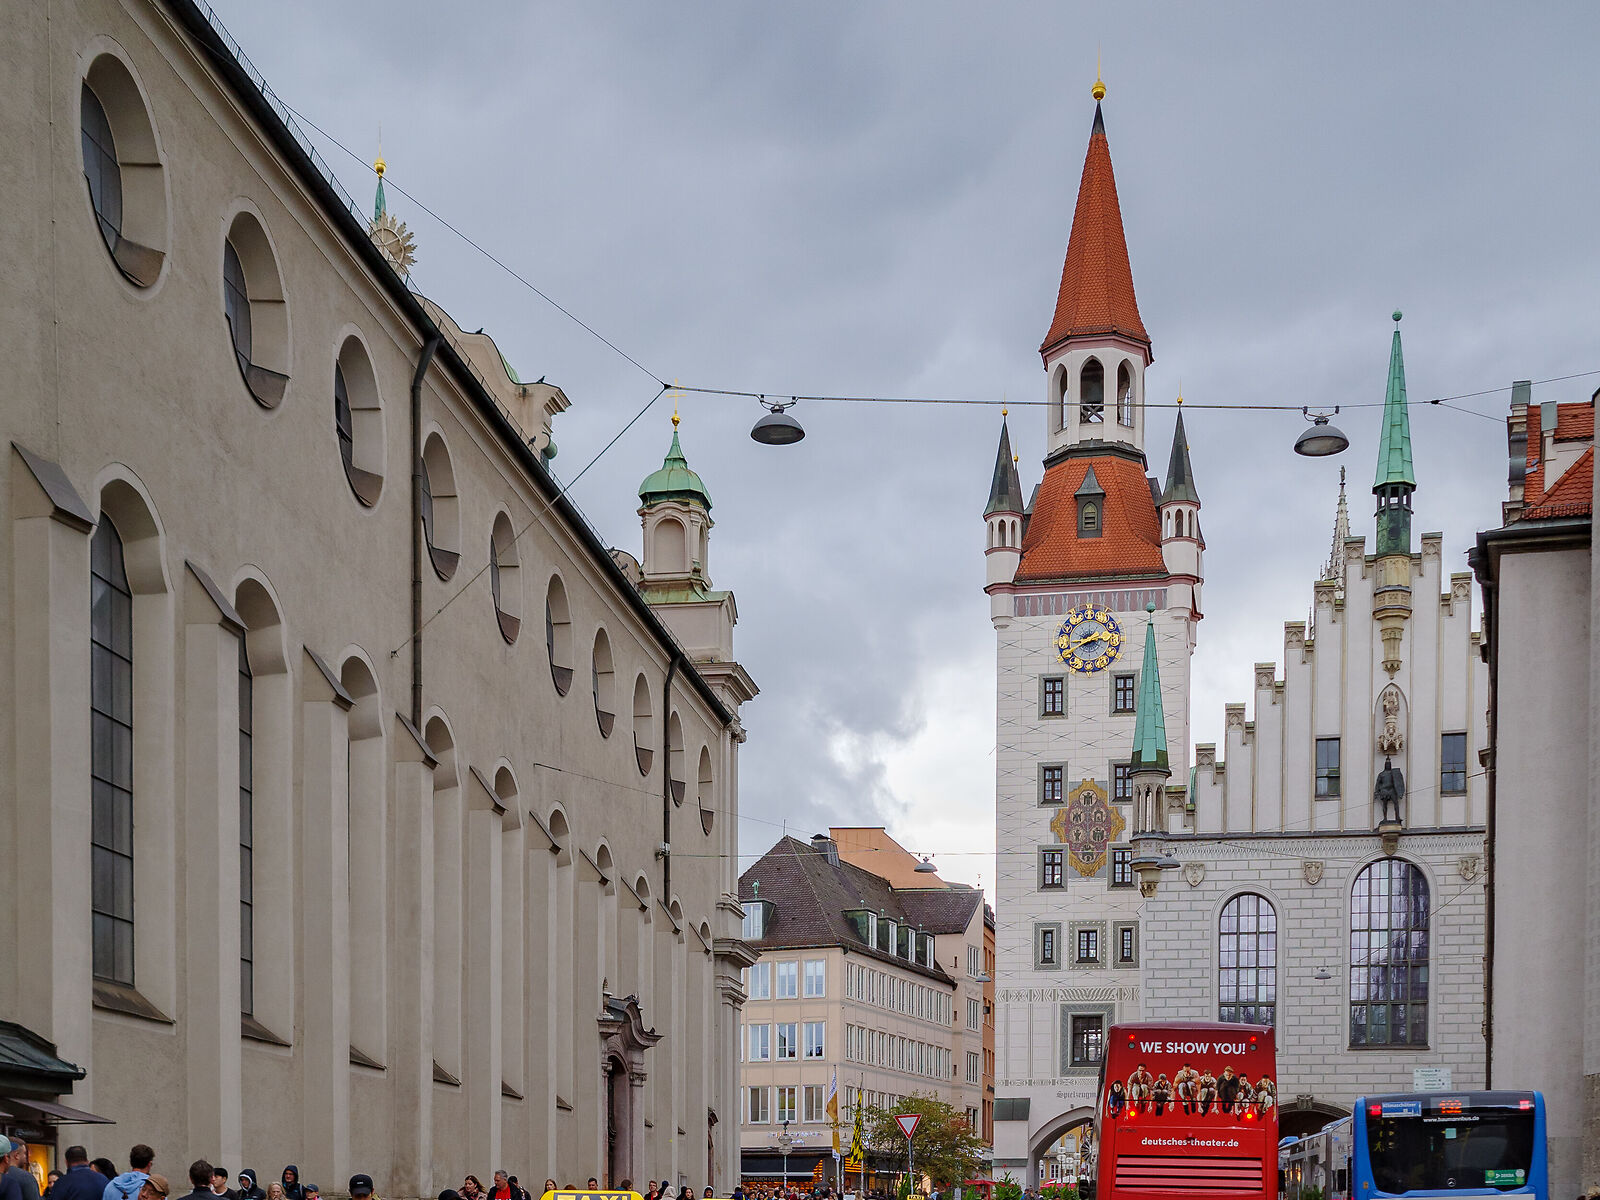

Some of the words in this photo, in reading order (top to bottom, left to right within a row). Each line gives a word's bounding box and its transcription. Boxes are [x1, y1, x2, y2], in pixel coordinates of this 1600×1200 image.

[1140, 1041, 1162, 1053] WE
[1166, 1042, 1209, 1054] SHOW
[1212, 1043, 1246, 1055] YOU!
[1141, 1137, 1239, 1147] deutsches-theater.de
